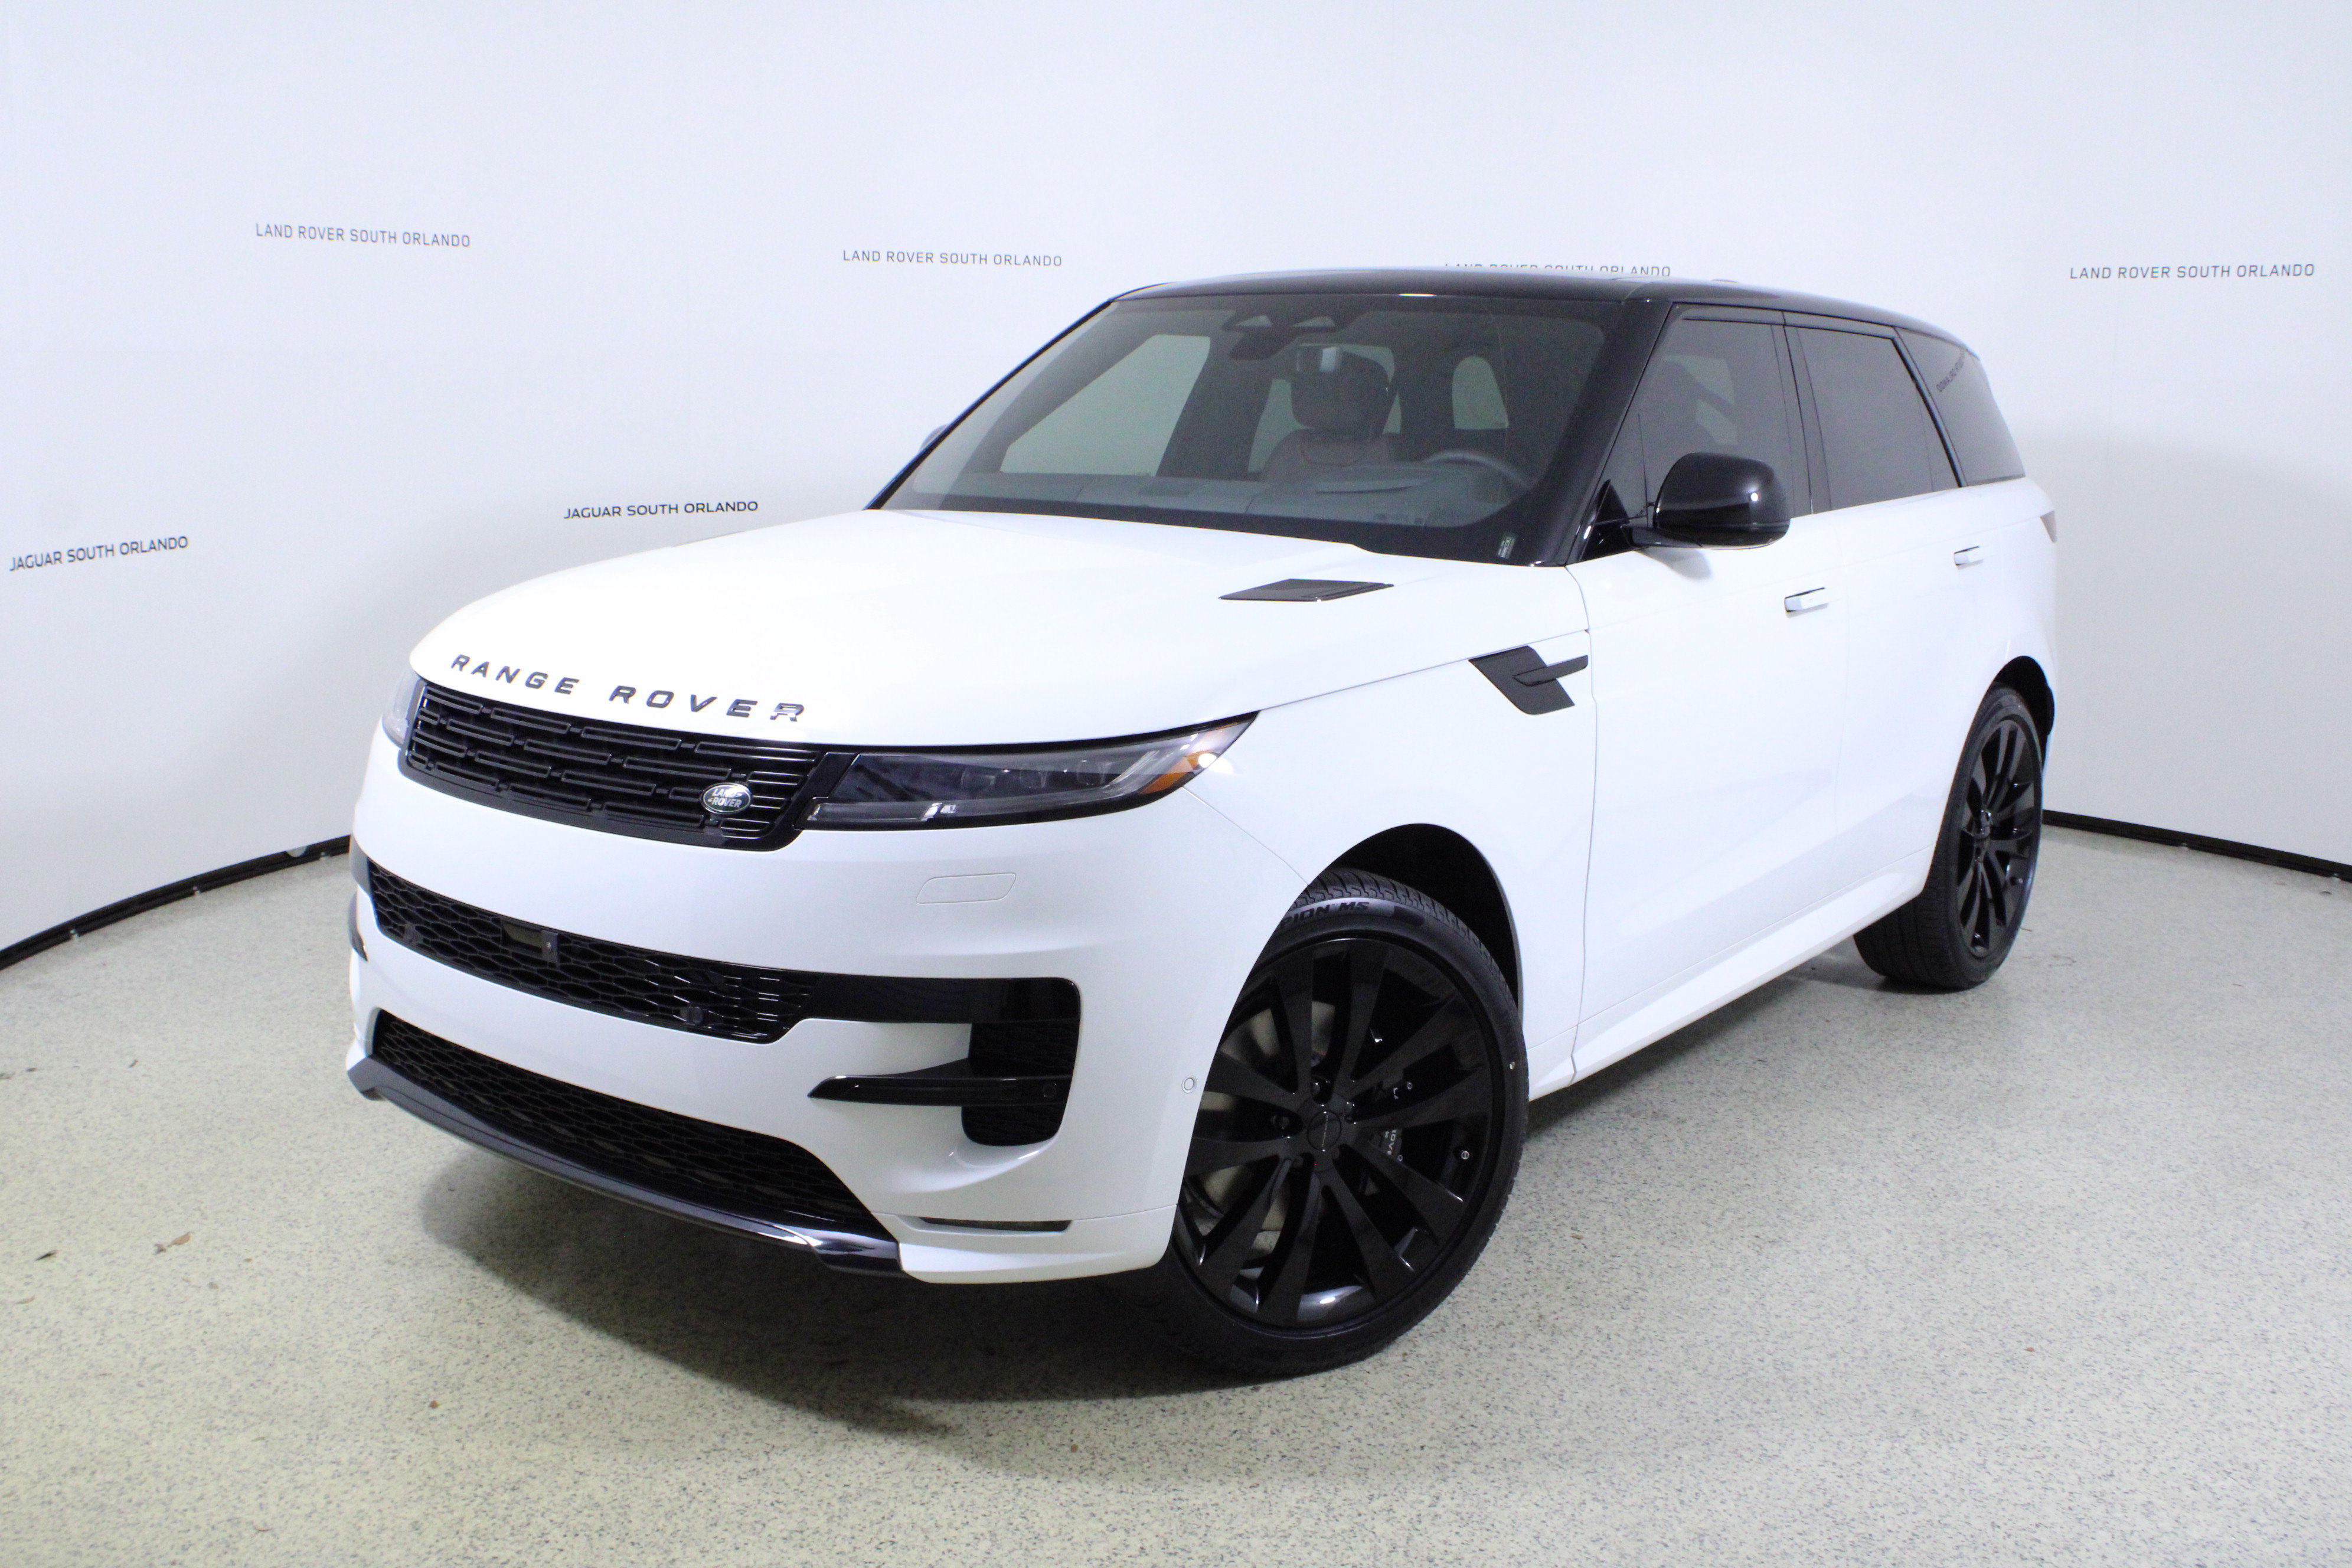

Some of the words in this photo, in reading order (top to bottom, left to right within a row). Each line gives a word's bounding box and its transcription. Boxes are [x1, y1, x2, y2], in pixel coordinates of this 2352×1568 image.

[256, 223, 292, 239] LAND
[298, 226, 344, 241] ROVER
[350, 228, 397, 243] SOUTH
[403, 231, 470, 248] ORLANDO
[844, 250, 880, 262] LAND
[887, 251, 933, 263] ROVER
[940, 252, 987, 264] SOUTH
[994, 254, 1061, 267] ORLANDO
[2070, 267, 2111, 279] LAND
[2118, 266, 2170, 279] ROVER
[2177, 265, 2230, 278] SOUTH
[2237, 263, 2314, 277] ORLANDO
[564, 506, 621, 519] JAGUAR
[627, 504, 678, 516] SOUTH
[684, 501, 758, 514] ORLANDO
[9, 551, 62, 571] JAGUAR
[67, 544, 115, 563] SOUTH
[120, 535, 188, 556] ORLANDO
[450, 654, 580, 695] RANGE
[609, 685, 805, 722] ROVER
[711, 798, 743, 808] ROVER
